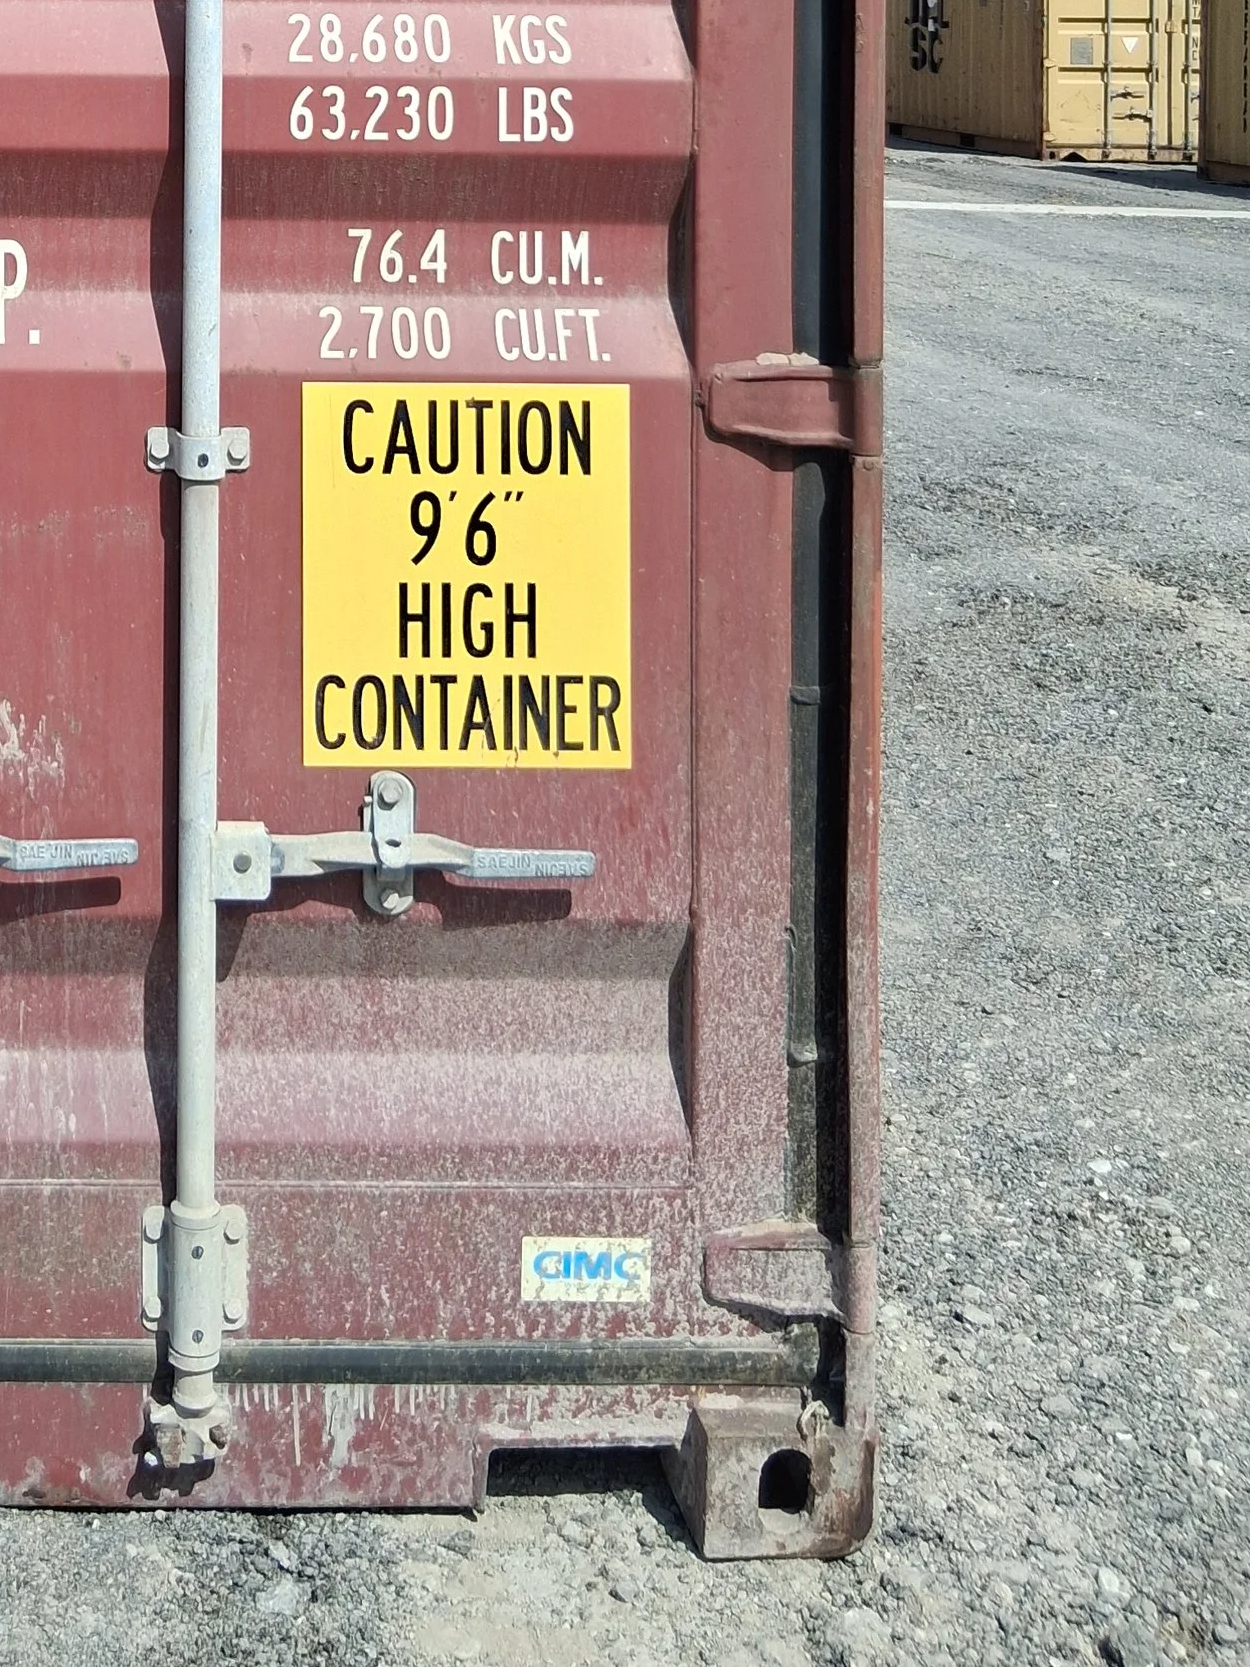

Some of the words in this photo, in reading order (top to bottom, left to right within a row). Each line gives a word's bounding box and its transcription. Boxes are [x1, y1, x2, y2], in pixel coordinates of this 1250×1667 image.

[287, 13, 452, 64] 28,680
[492, 14, 574, 65] KGS
[289, 85, 454, 141] 63,230
[498, 86, 575, 143] LBS
[347, 228, 448, 285] 76.4
[318, 305, 451, 360] 2,700
[343, 399, 591, 476] CAUTION
[398, 582, 537, 659] HIGH
[315, 674, 621, 751] CONTAINER
[19, 843, 73, 859] SAEJIN
[476, 853, 531, 869] SAEJIN
[533, 1249, 646, 1281] CIMC
